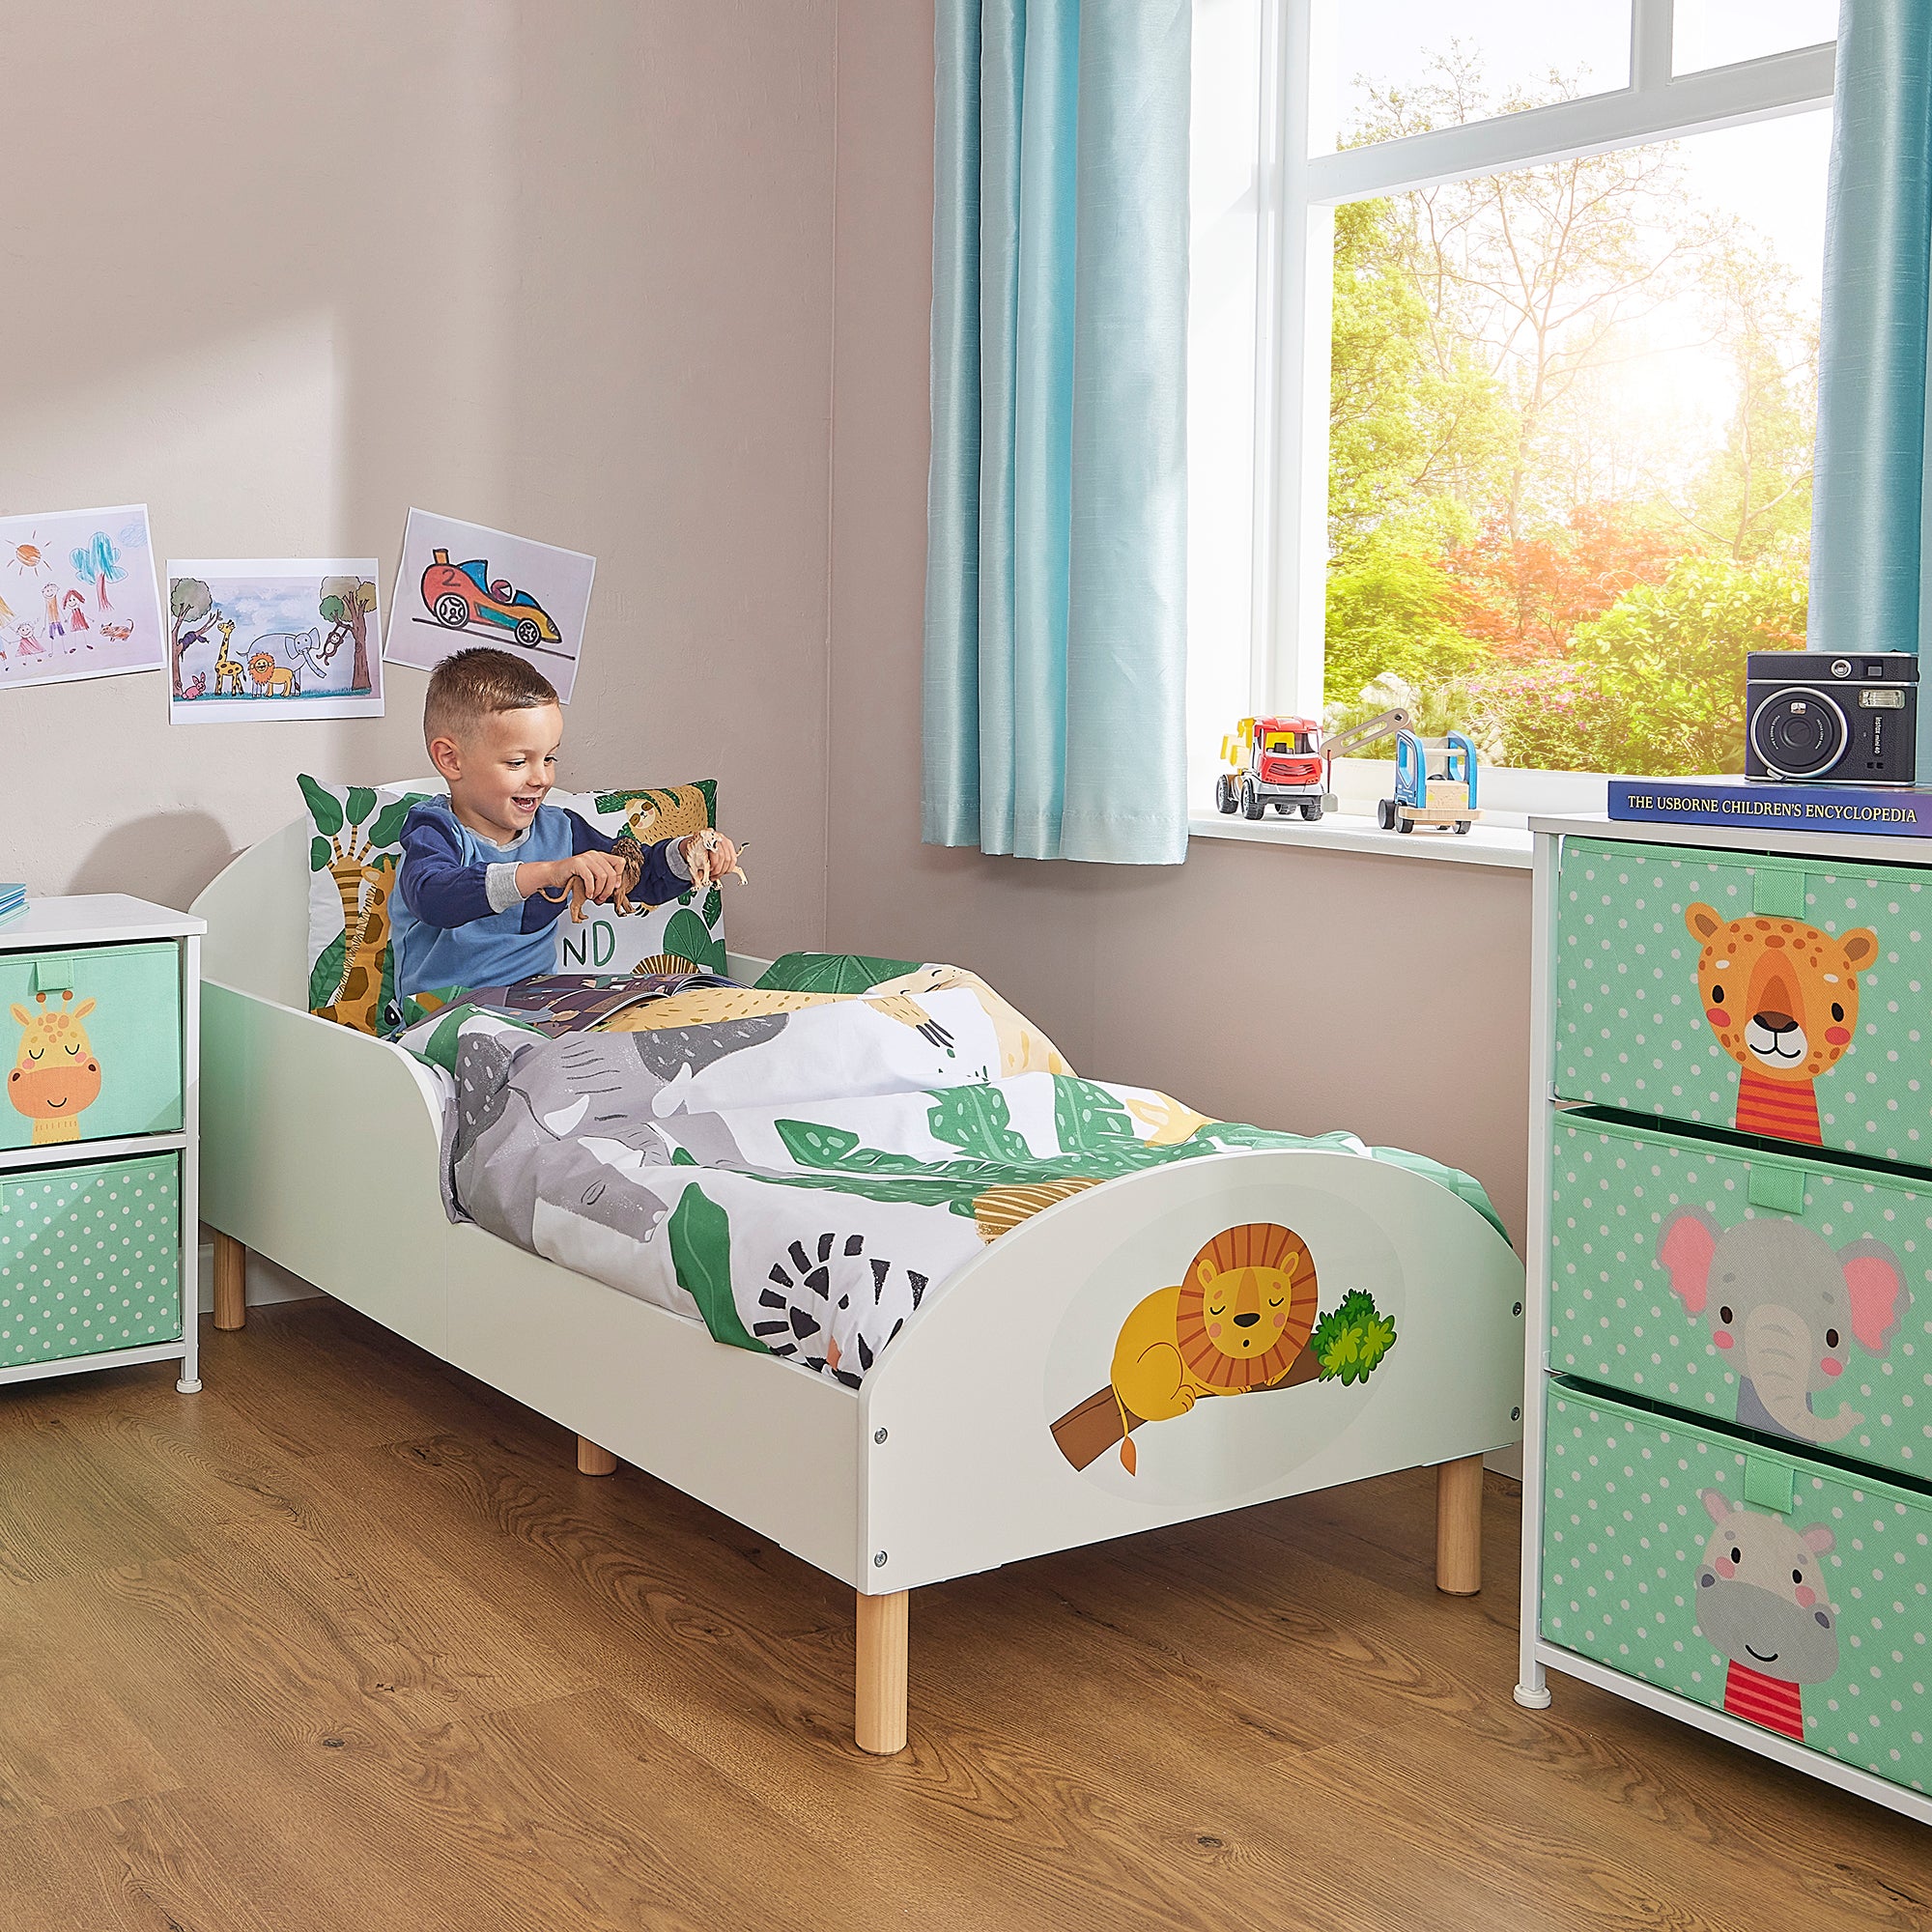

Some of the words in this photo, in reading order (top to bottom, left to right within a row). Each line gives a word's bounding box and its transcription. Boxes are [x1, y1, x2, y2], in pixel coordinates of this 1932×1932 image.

[441, 568, 461, 587] 2
[1627, 795, 1654, 809] THE
[1657, 796, 1719, 812] USBORNE
[1721, 800, 1803, 817] CHILDREN'S
[1805, 804, 1918, 823] ENCYCLOPEDIA
